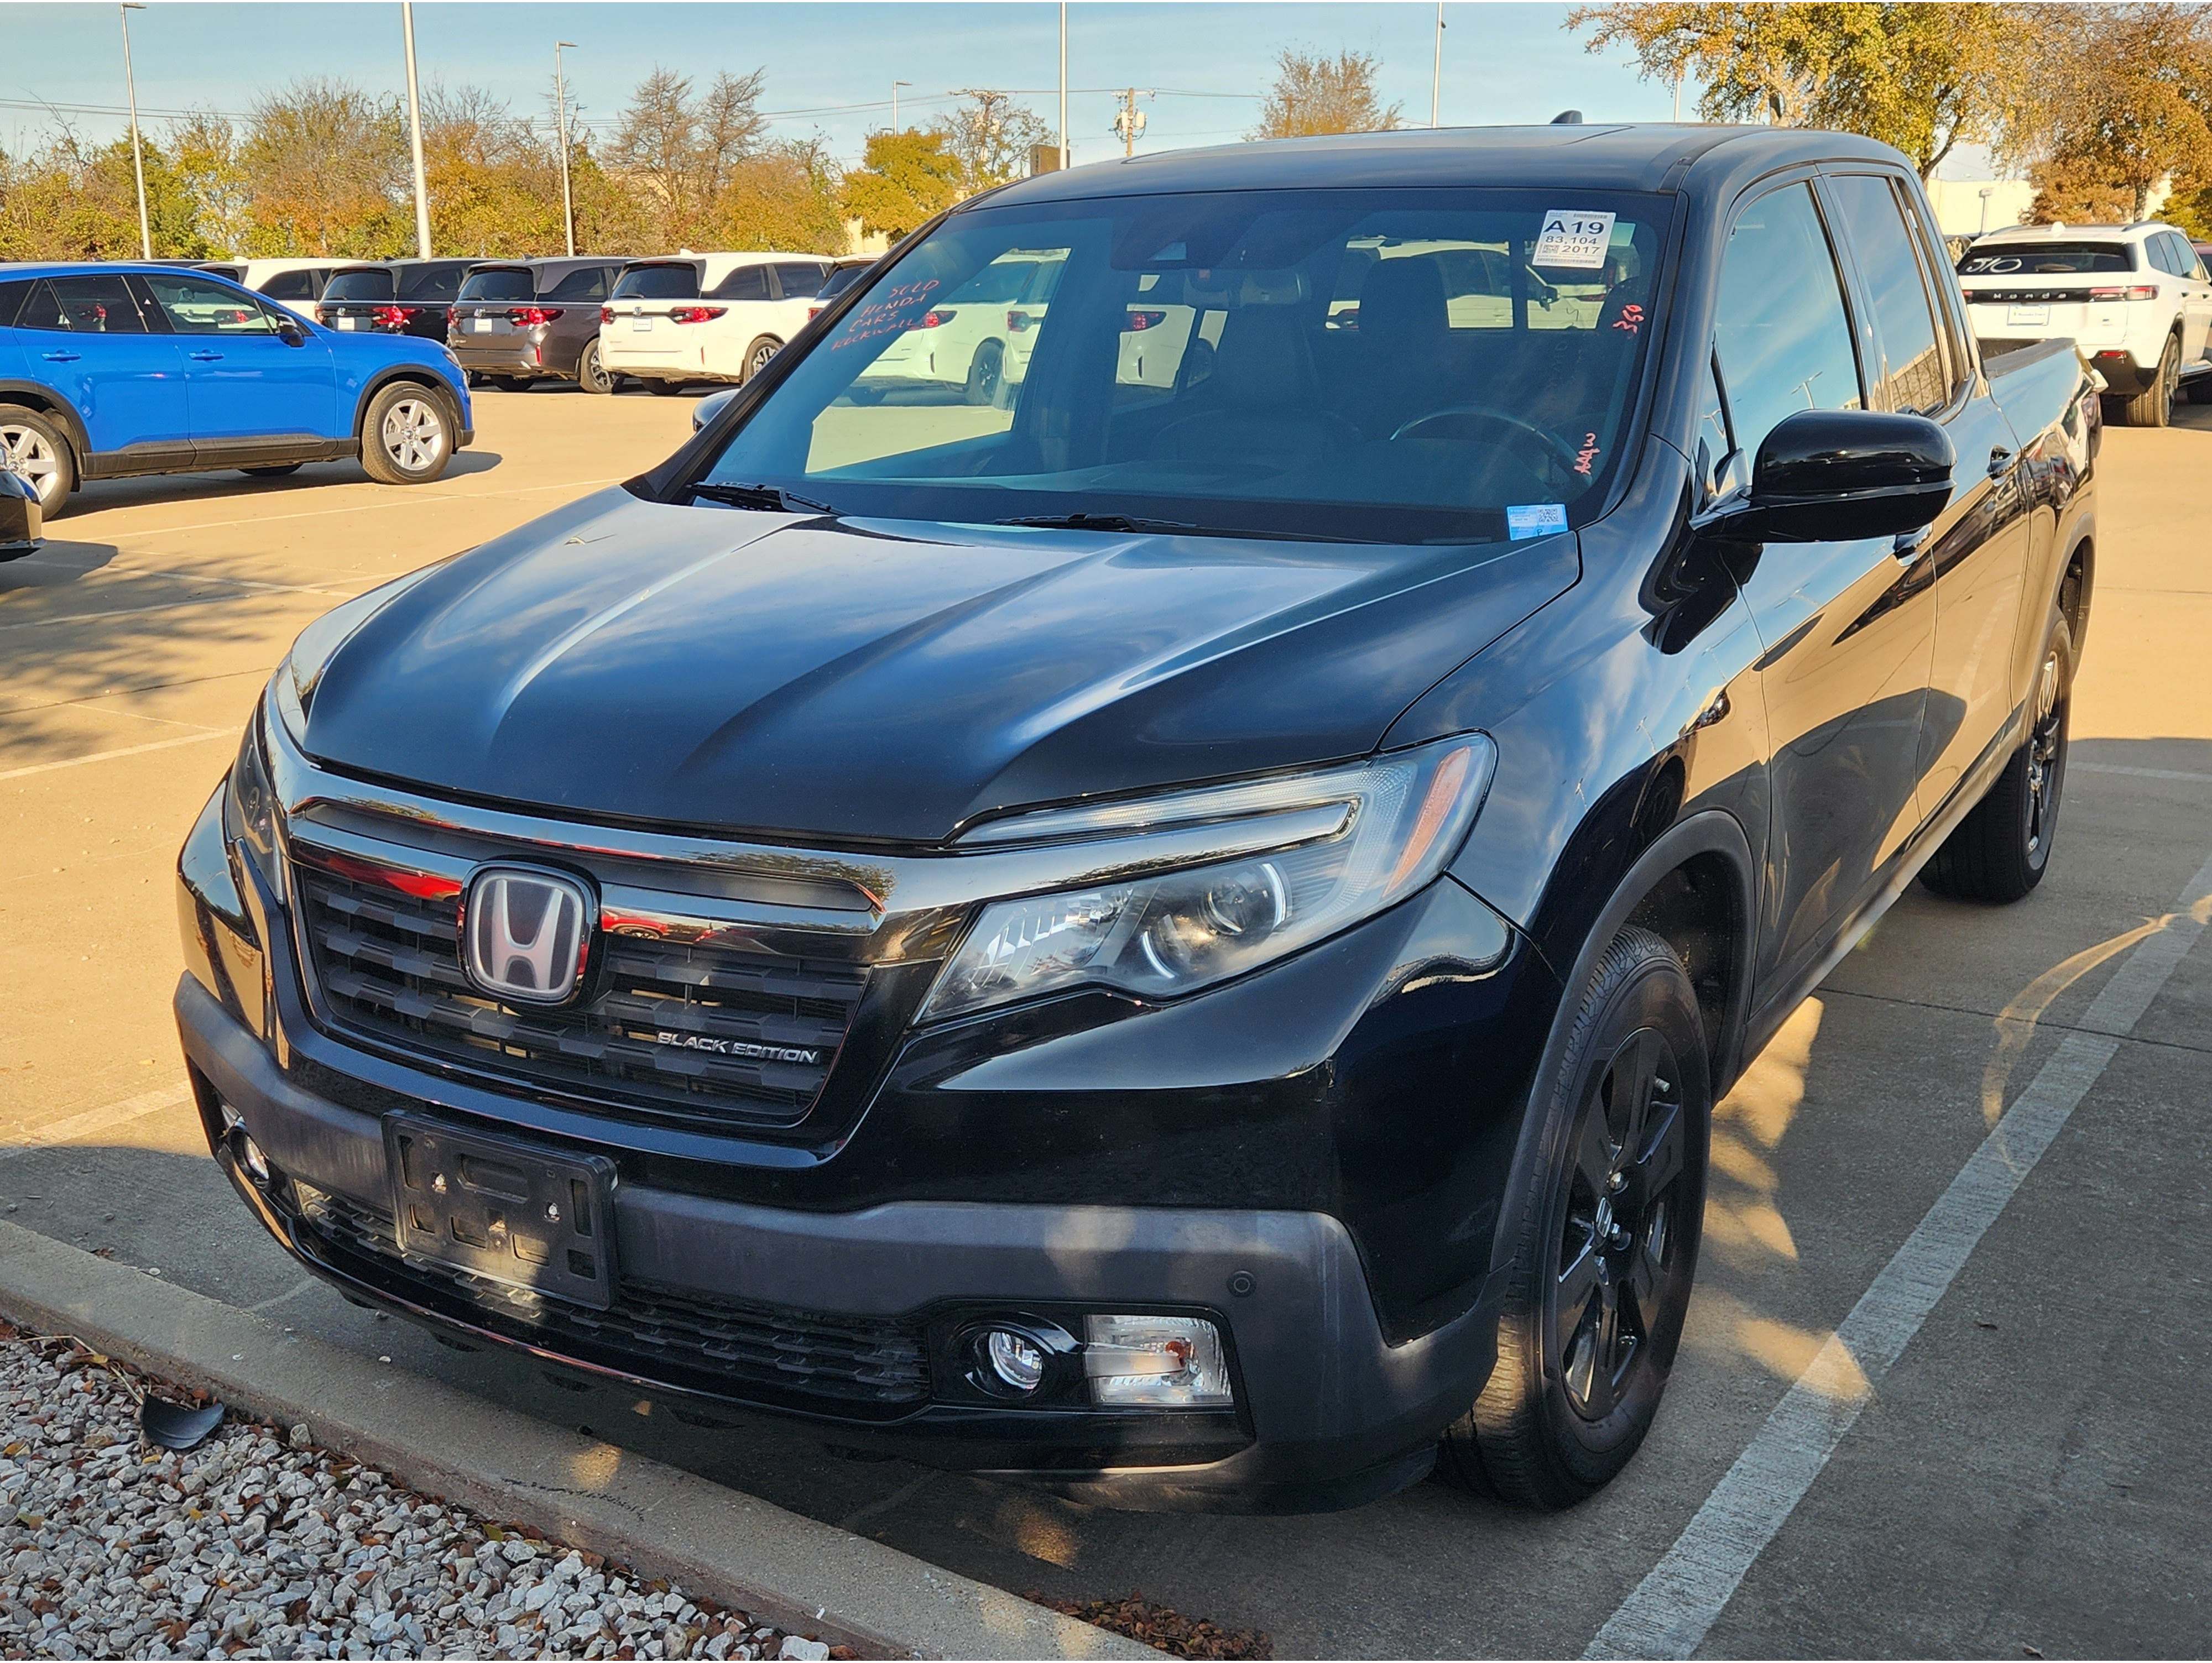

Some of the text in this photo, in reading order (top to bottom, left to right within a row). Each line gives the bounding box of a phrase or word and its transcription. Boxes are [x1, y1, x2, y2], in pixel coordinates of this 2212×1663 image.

[1543, 219, 1604, 234] A19
[1546, 236, 1597, 245] 83,104
[1562, 245, 1600, 254] 2017
[849, 310, 900, 332] CARS
[657, 1032, 817, 1064] BLACK EDITION
